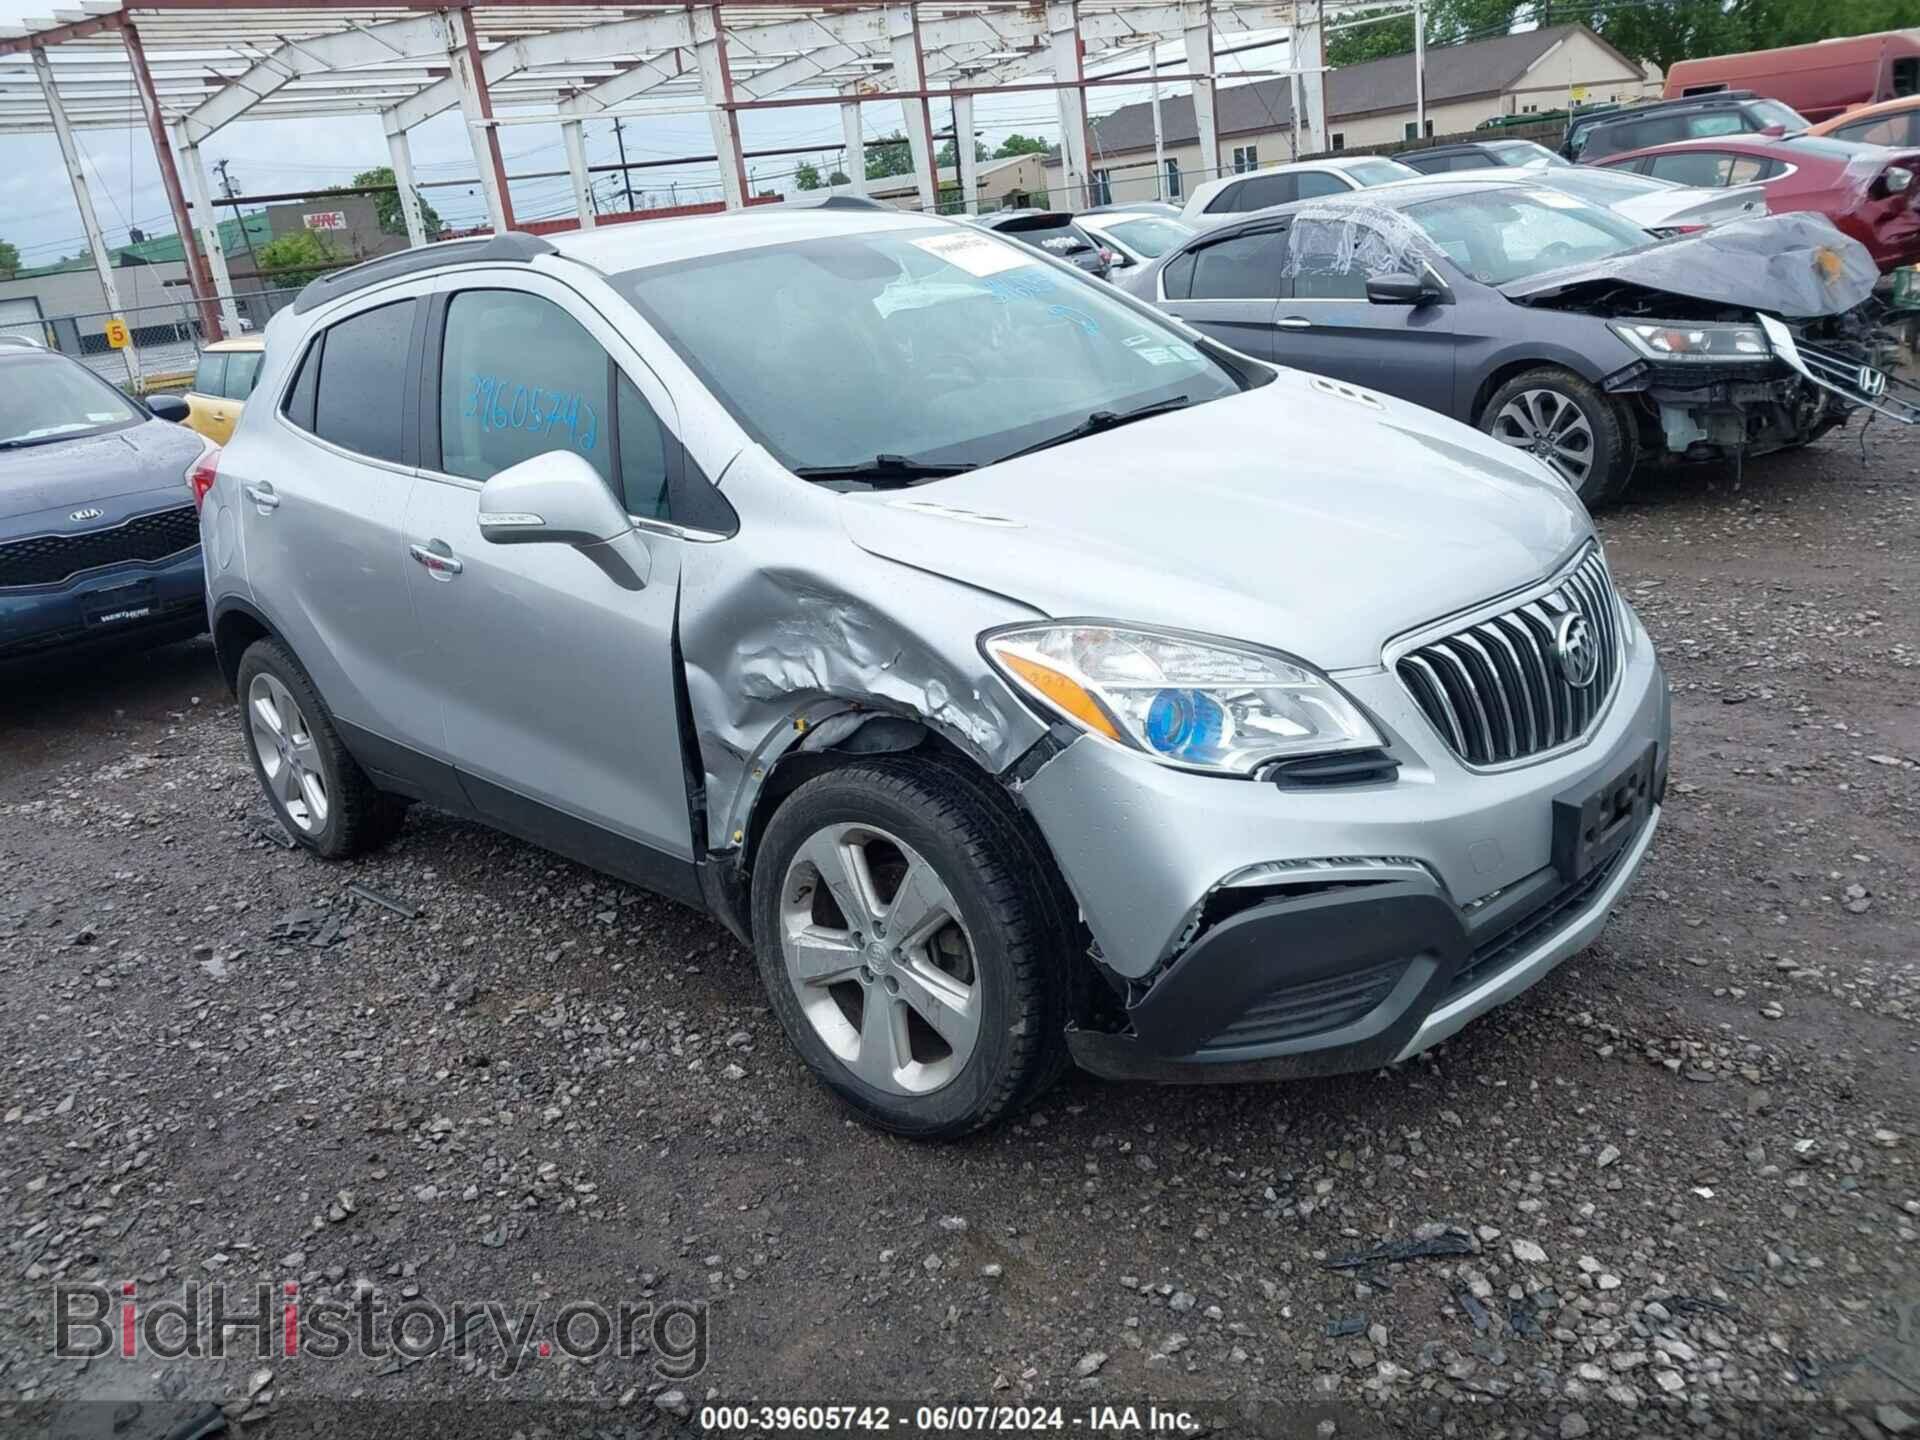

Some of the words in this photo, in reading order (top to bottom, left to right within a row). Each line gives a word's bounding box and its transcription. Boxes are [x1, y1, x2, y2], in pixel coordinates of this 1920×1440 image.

[112, 325, 124, 341] 5
[464, 375, 598, 449] 39605742
[74, 508, 102, 520] KIA
